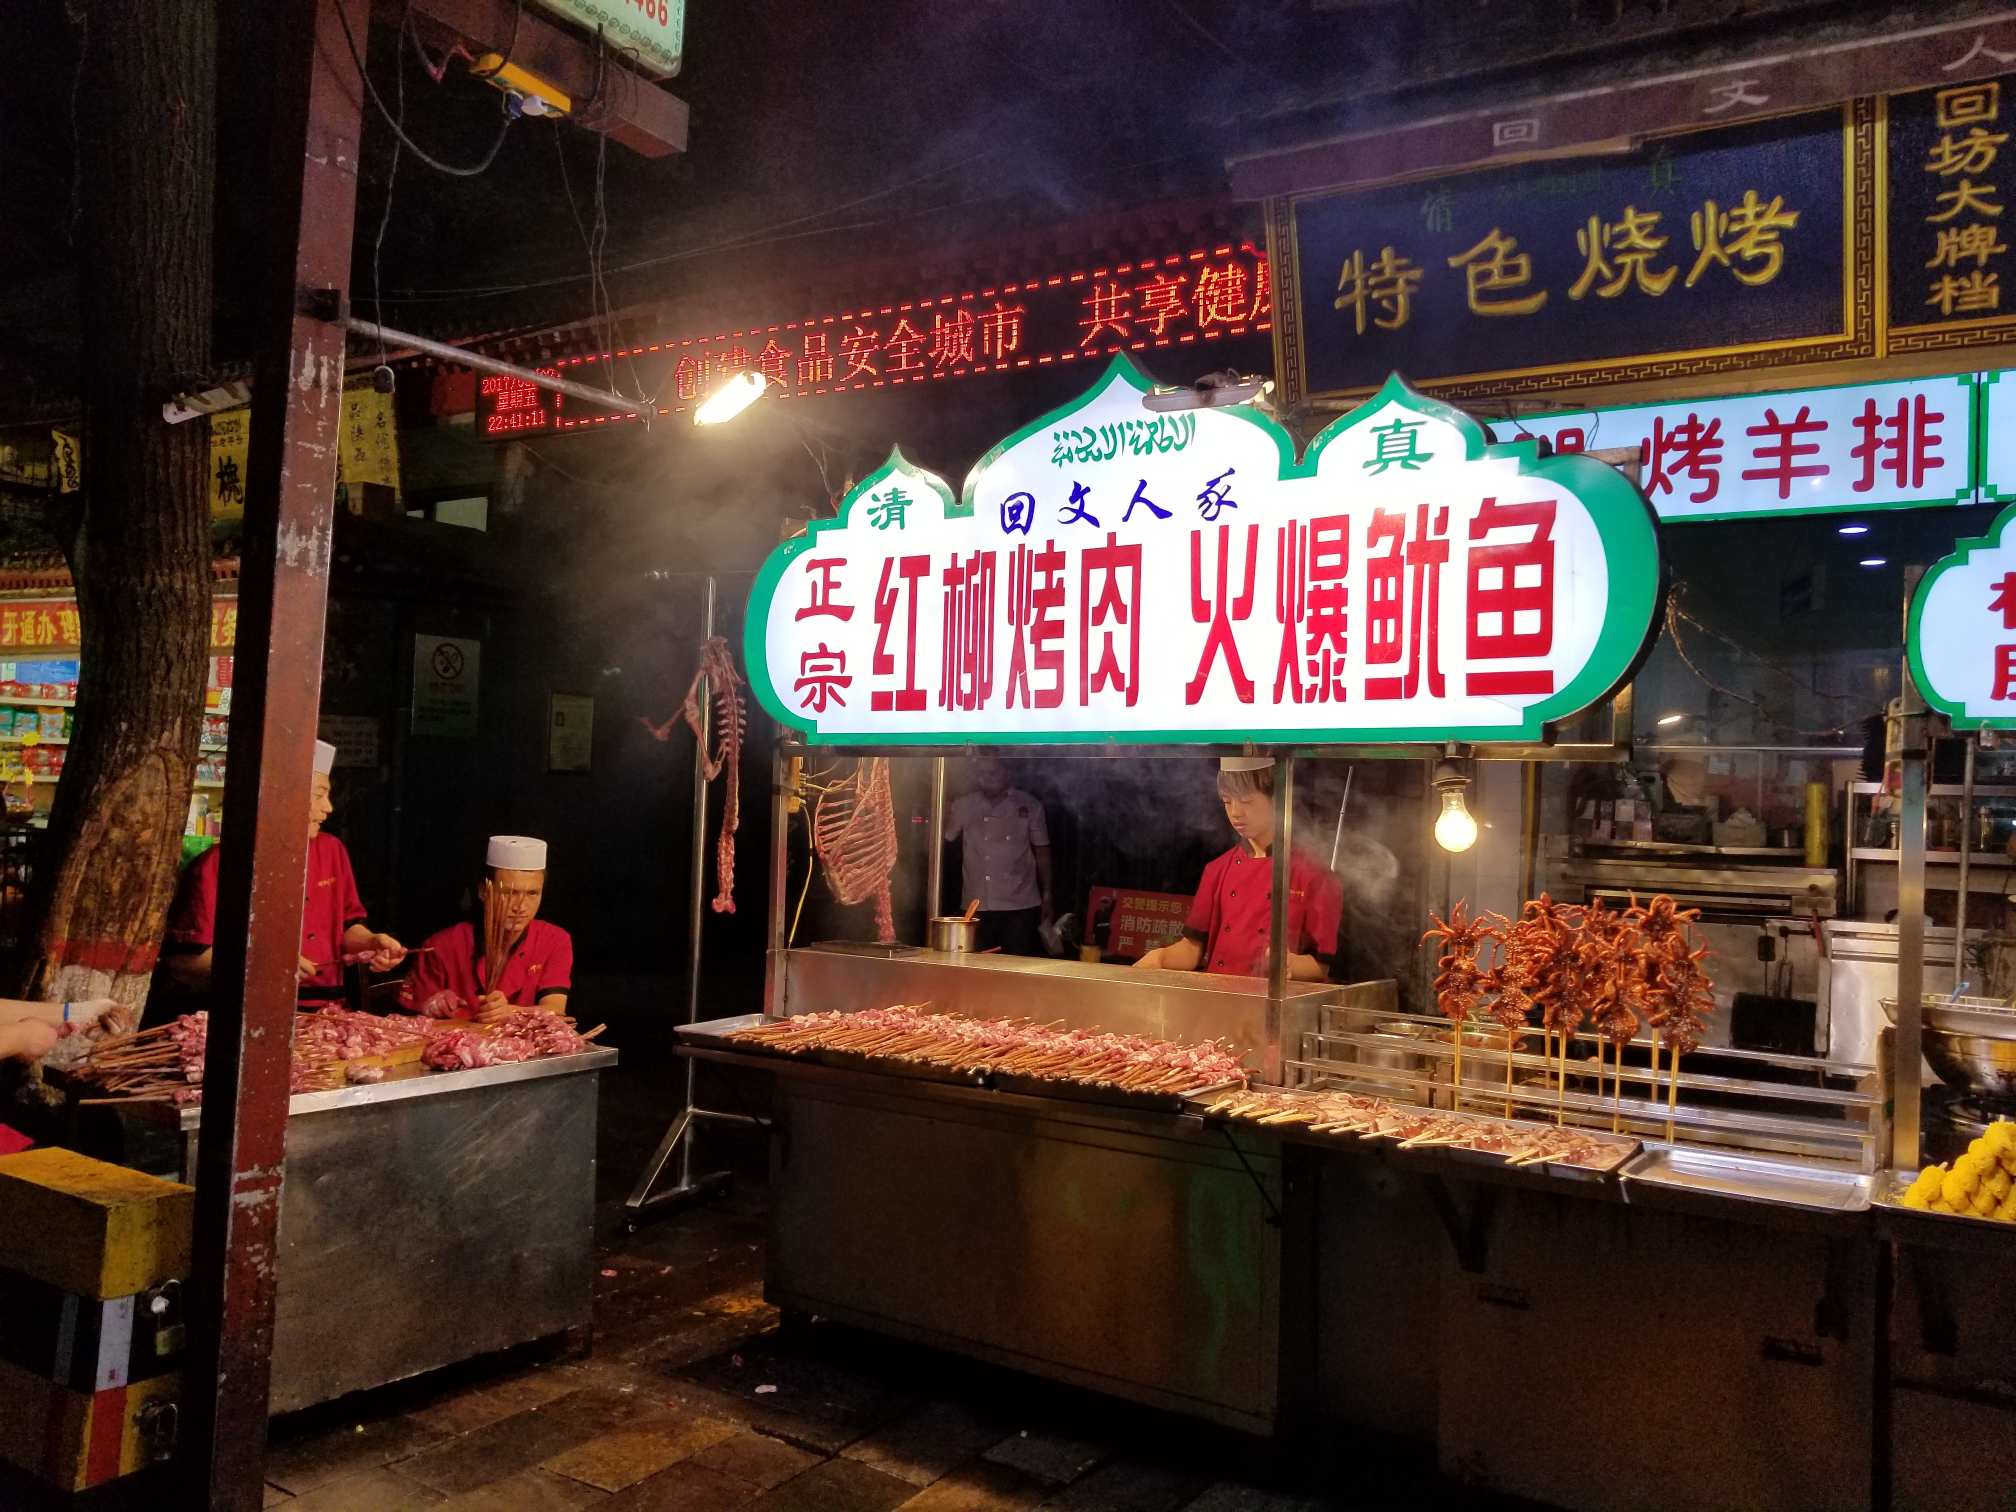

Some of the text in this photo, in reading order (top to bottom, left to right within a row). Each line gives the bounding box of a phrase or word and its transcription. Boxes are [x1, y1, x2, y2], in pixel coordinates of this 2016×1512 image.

[1924, 80, 2010, 316] 回坊大牌档
[1334, 190, 1799, 335] 特色烧烤
[488, 410, 545, 432] 22:41:11
[496, 387, 537, 411] 星期五
[1362, 418, 1434, 476] 真
[1642, 392, 1945, 504] 烤羊排
[867, 486, 911, 531] 清
[795, 558, 854, 712] 正宗
[871, 498, 1557, 712] 红柳烤肉 火爆鱿鱼
